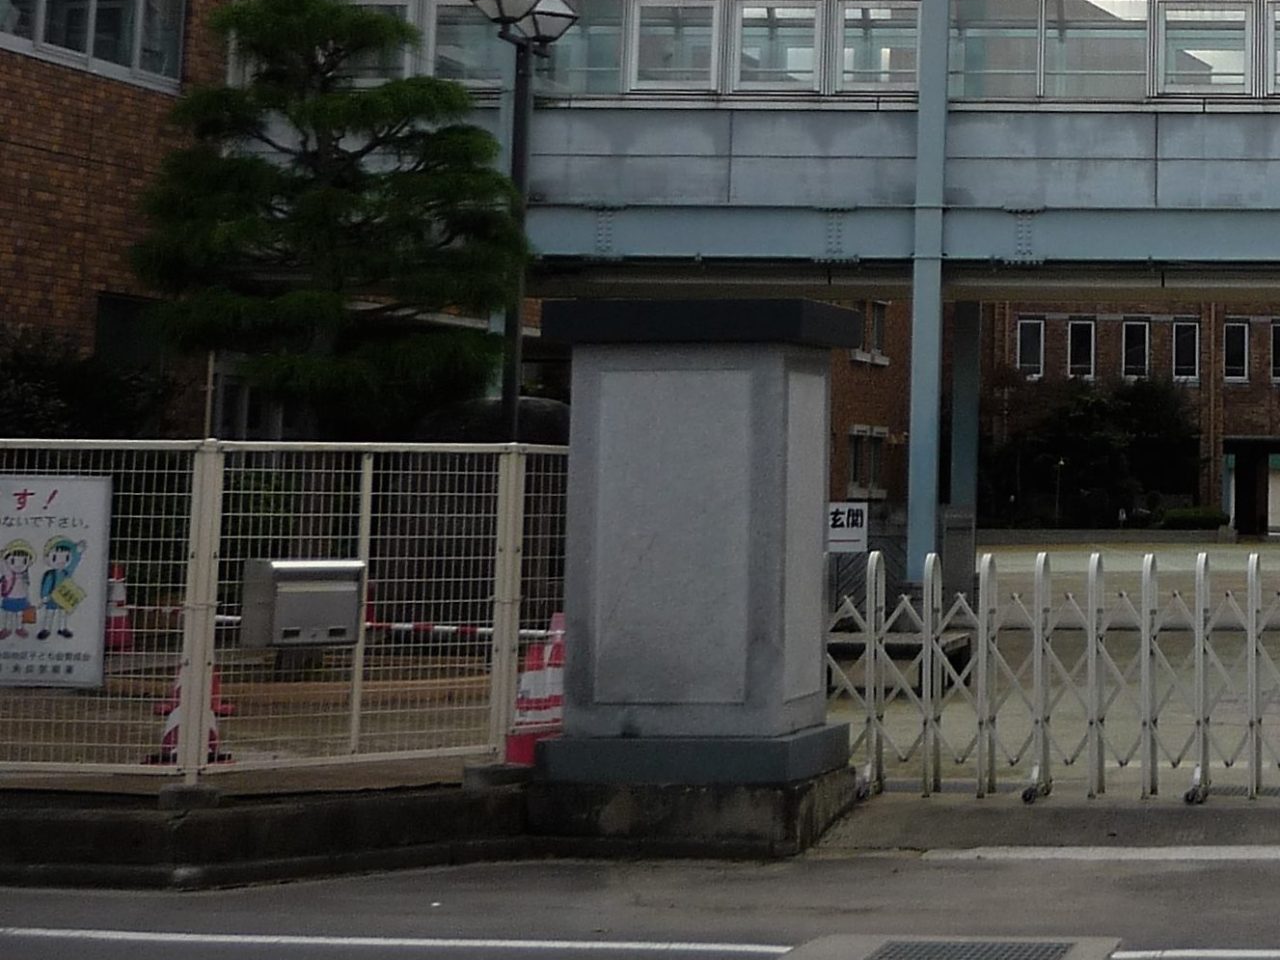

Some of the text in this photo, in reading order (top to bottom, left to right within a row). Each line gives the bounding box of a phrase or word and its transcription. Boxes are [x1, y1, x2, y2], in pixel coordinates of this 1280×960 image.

[0, 515, 90, 529] ないで下さい。
[830, 508, 864, 528] 玄関
